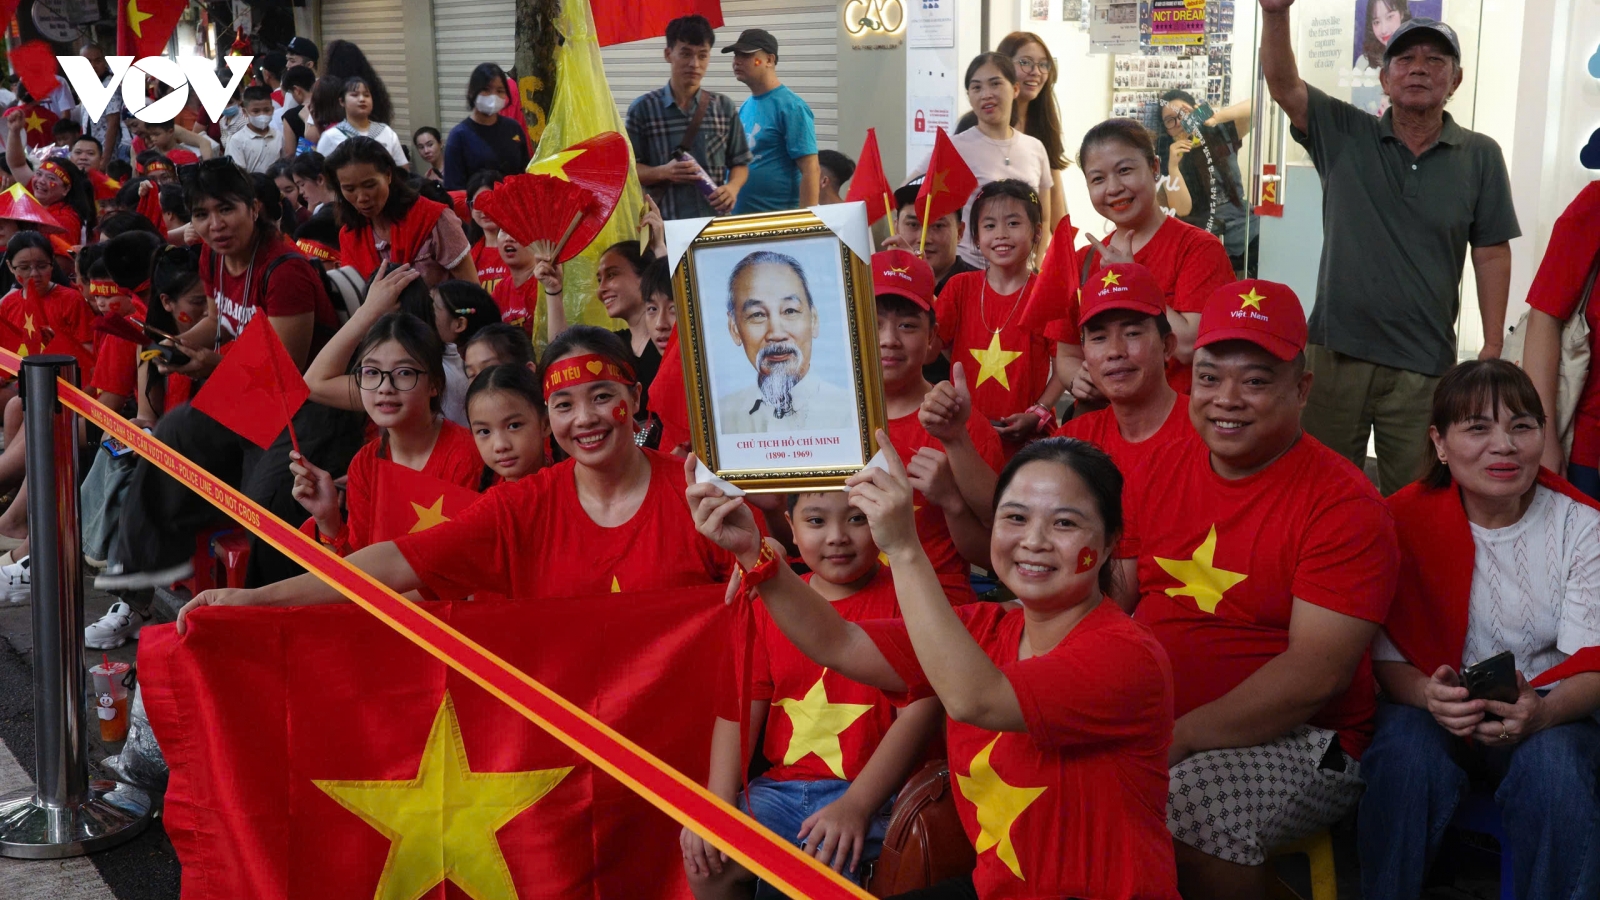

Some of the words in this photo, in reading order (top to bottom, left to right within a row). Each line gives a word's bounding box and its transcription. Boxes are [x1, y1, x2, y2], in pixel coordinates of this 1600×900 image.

[1153, 11, 1172, 22] NCT
[1173, 9, 1205, 21] DREAM
[1309, 28, 1317, 37] the
[1317, 28, 1329, 37] first
[1330, 27, 1342, 36] time
[1314, 39, 1335, 49] capture
[1309, 49, 1317, 58] the
[1318, 49, 1342, 59] memory
[1314, 59, 1321, 68] of
[1324, 60, 1335, 69] day
[313, 247, 329, 258] NAM
[1097, 287, 1110, 296] Việt
[1230, 309, 1247, 319] Việt
[1250, 310, 1269, 322] Nam
[550, 370, 561, 386] TÔI
[562, 365, 581, 380] YÊU
[737, 439, 756, 449] CHỦ
[757, 439, 779, 449] TỊCH
[781, 436, 795, 447] HỒ
[796, 436, 813, 446] CHÍ
[815, 436, 840, 446] MINH
[765, 451, 786, 460] (1890
[793, 450, 813, 459] 1969)
[179, 463, 199, 487] POLICE
[214, 487, 224, 503] DO
[224, 493, 238, 512] NOT
[238, 503, 260, 528] CROSS
